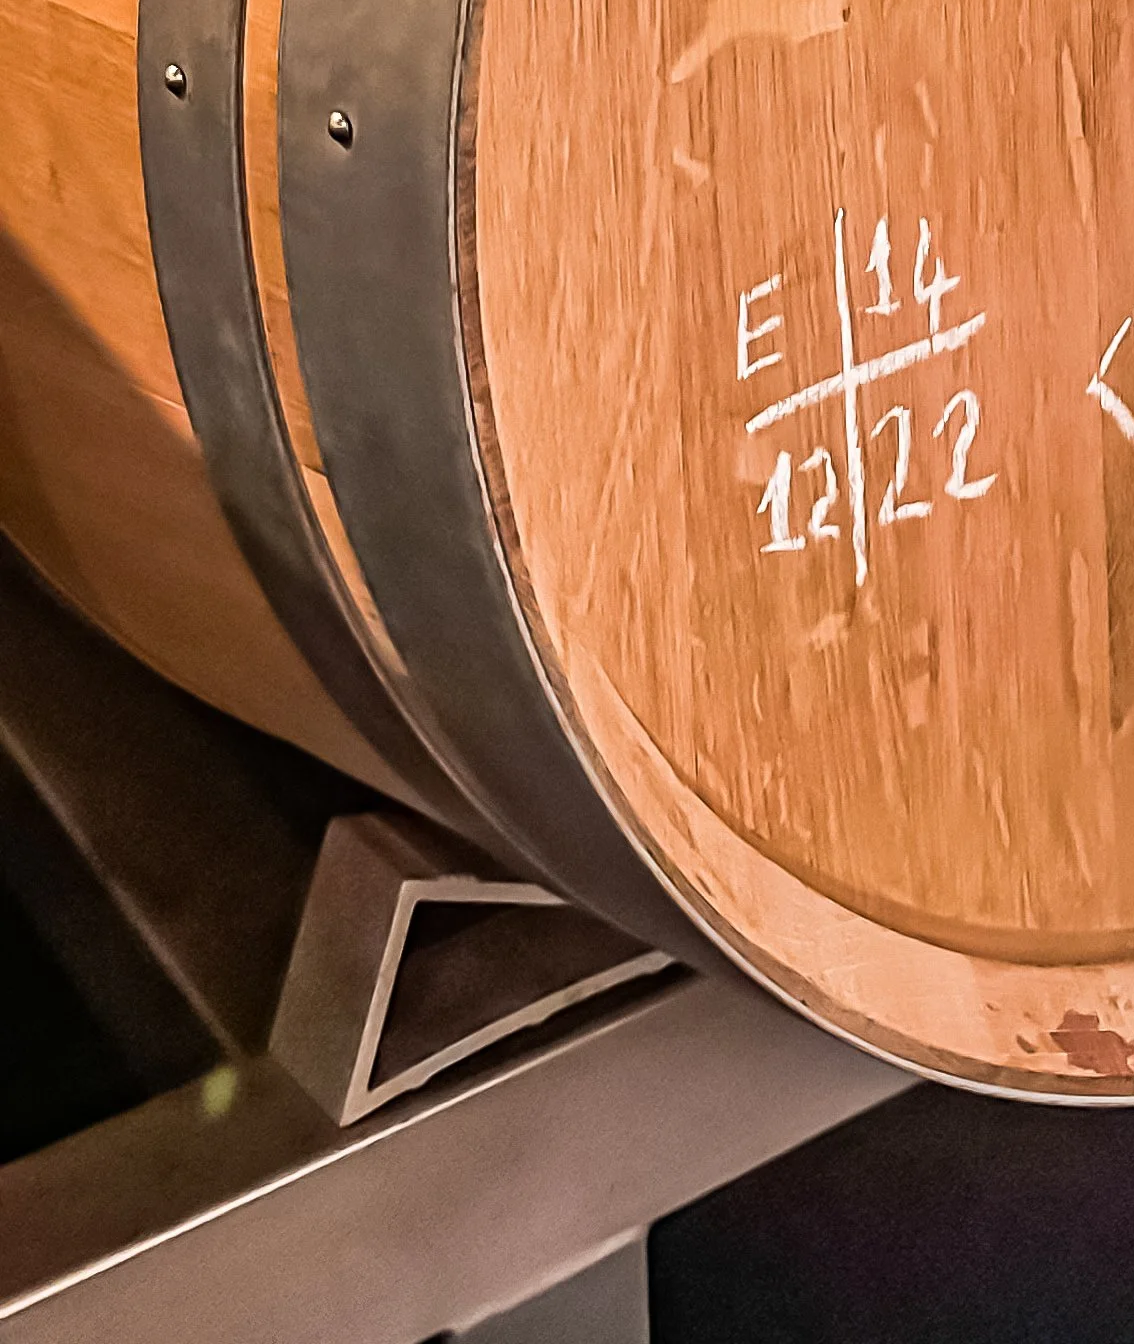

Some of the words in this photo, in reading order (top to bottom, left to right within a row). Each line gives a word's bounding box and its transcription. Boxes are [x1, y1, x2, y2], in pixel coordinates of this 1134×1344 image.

[736, 273, 783, 380] E
[856, 215, 961, 333] 14
[756, 446, 841, 553] 12
[871, 389, 998, 526] 22
